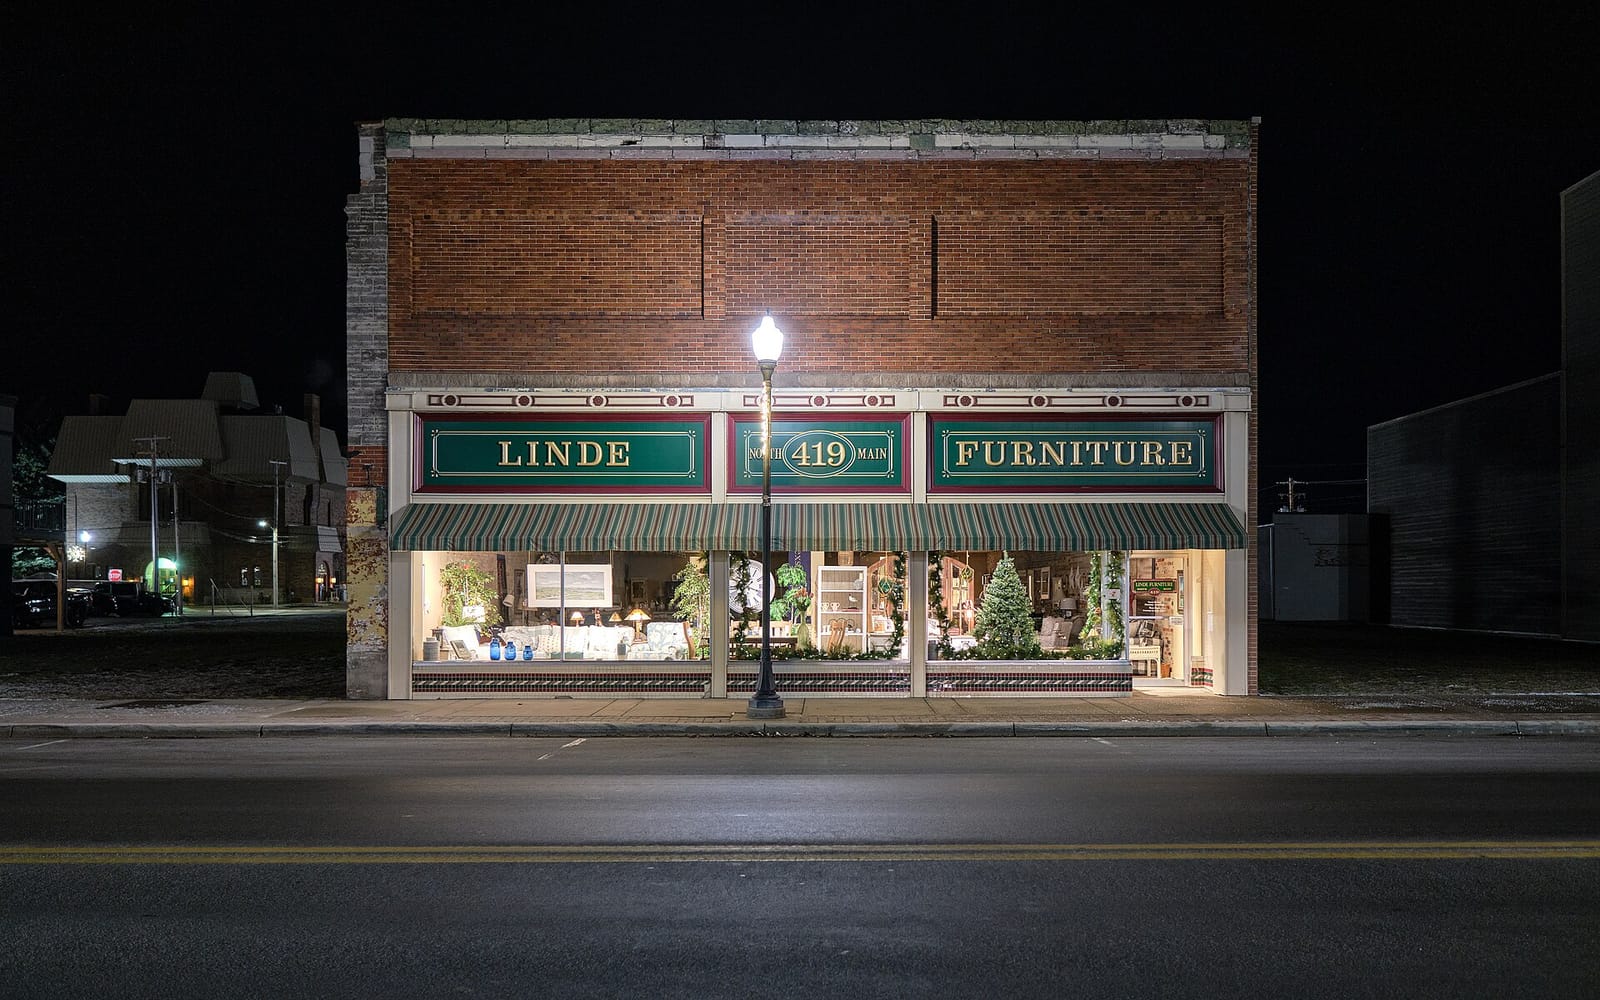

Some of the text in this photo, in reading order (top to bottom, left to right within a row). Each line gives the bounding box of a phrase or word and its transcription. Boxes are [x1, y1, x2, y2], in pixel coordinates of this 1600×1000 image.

[498, 441, 630, 466] LINDE
[749, 440, 887, 467] NOTH 419 MAIN
[955, 441, 1193, 466] FURNITURE
